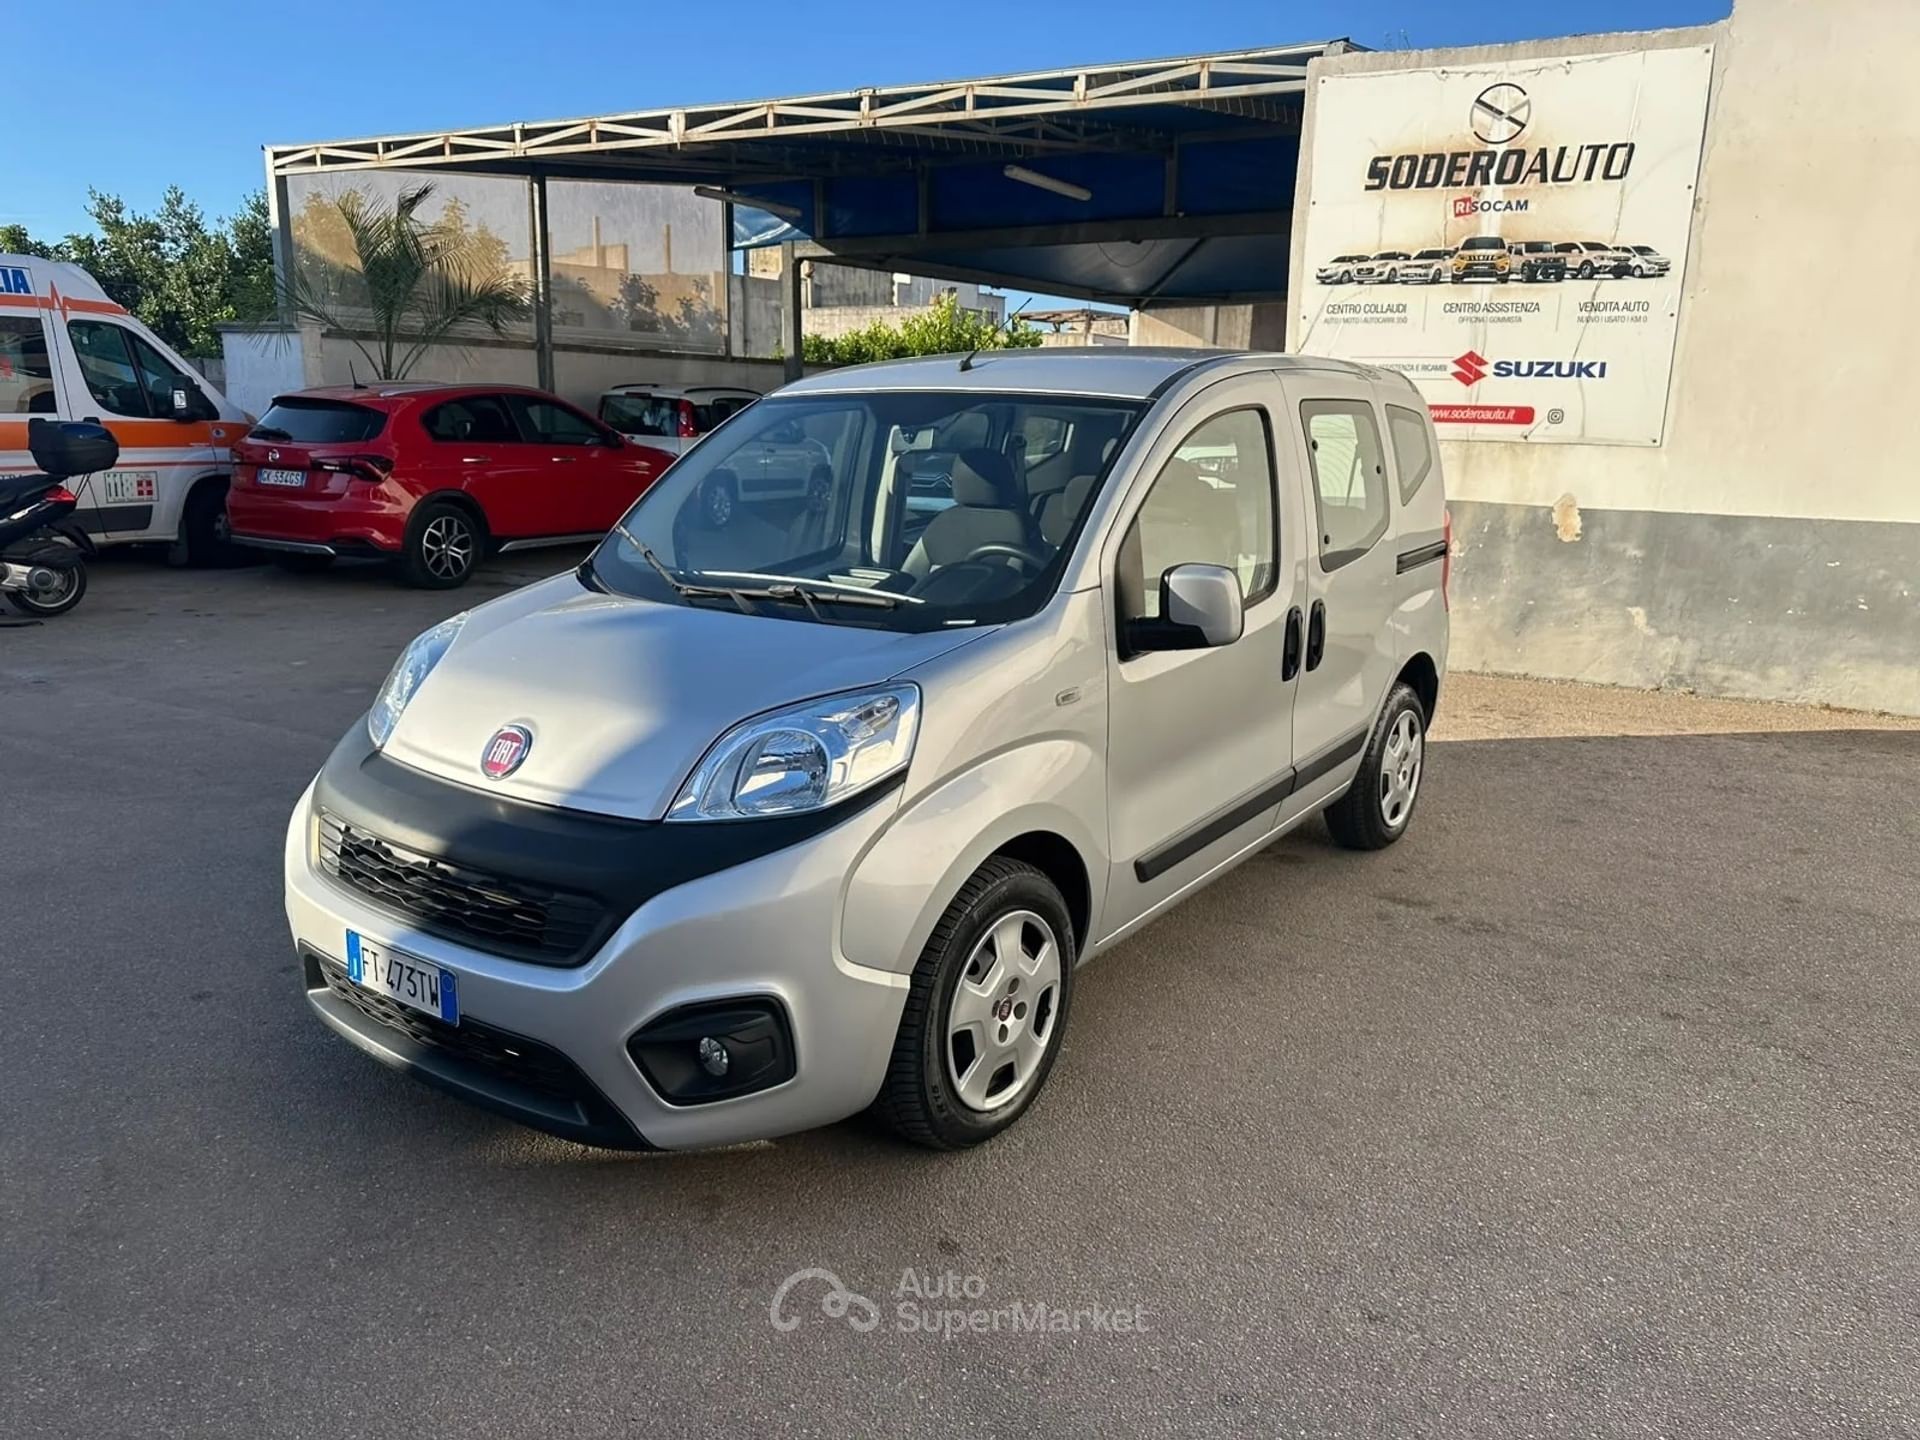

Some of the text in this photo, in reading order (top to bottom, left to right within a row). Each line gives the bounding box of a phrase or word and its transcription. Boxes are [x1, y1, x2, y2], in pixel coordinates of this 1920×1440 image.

[1364, 142, 1636, 192] SODEROAUTO
[1455, 199, 1529, 215] RISOCAM
[1326, 303, 1407, 314] CENTRO COLLAUDI
[1443, 302, 1540, 313] CENTRO ASSISTENZA
[1578, 301, 1650, 312] VENDITA AUTO
[1492, 360, 1607, 379] SUZUKI
[488, 738, 521, 766] FIAT
[361, 946, 440, 1008] FT 473TW
